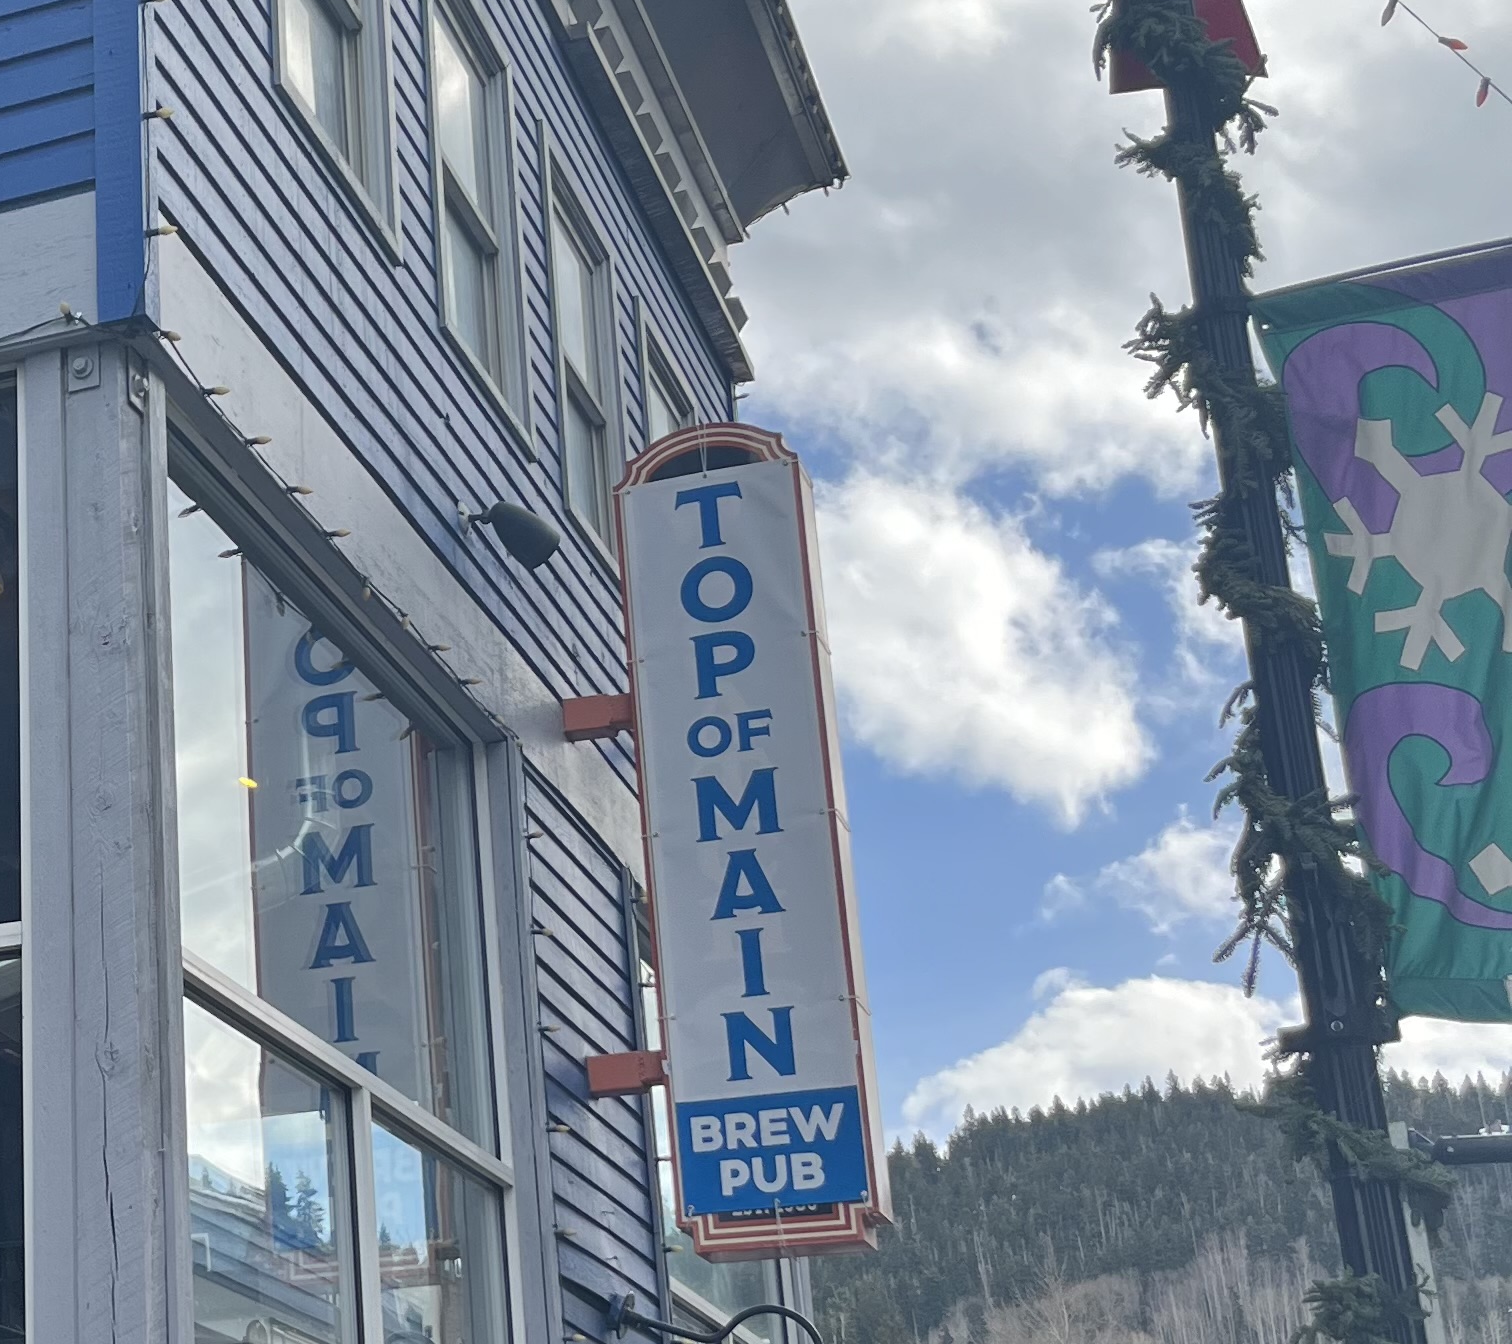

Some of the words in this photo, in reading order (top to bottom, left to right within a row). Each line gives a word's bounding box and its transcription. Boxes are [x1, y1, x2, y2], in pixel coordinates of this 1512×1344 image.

[674, 480, 755, 700] TOP
[686, 708, 774, 758] OF
[690, 766, 796, 1082] MAIN
[689, 1102, 845, 1153] BREW
[719, 1151, 826, 1197] PUB
